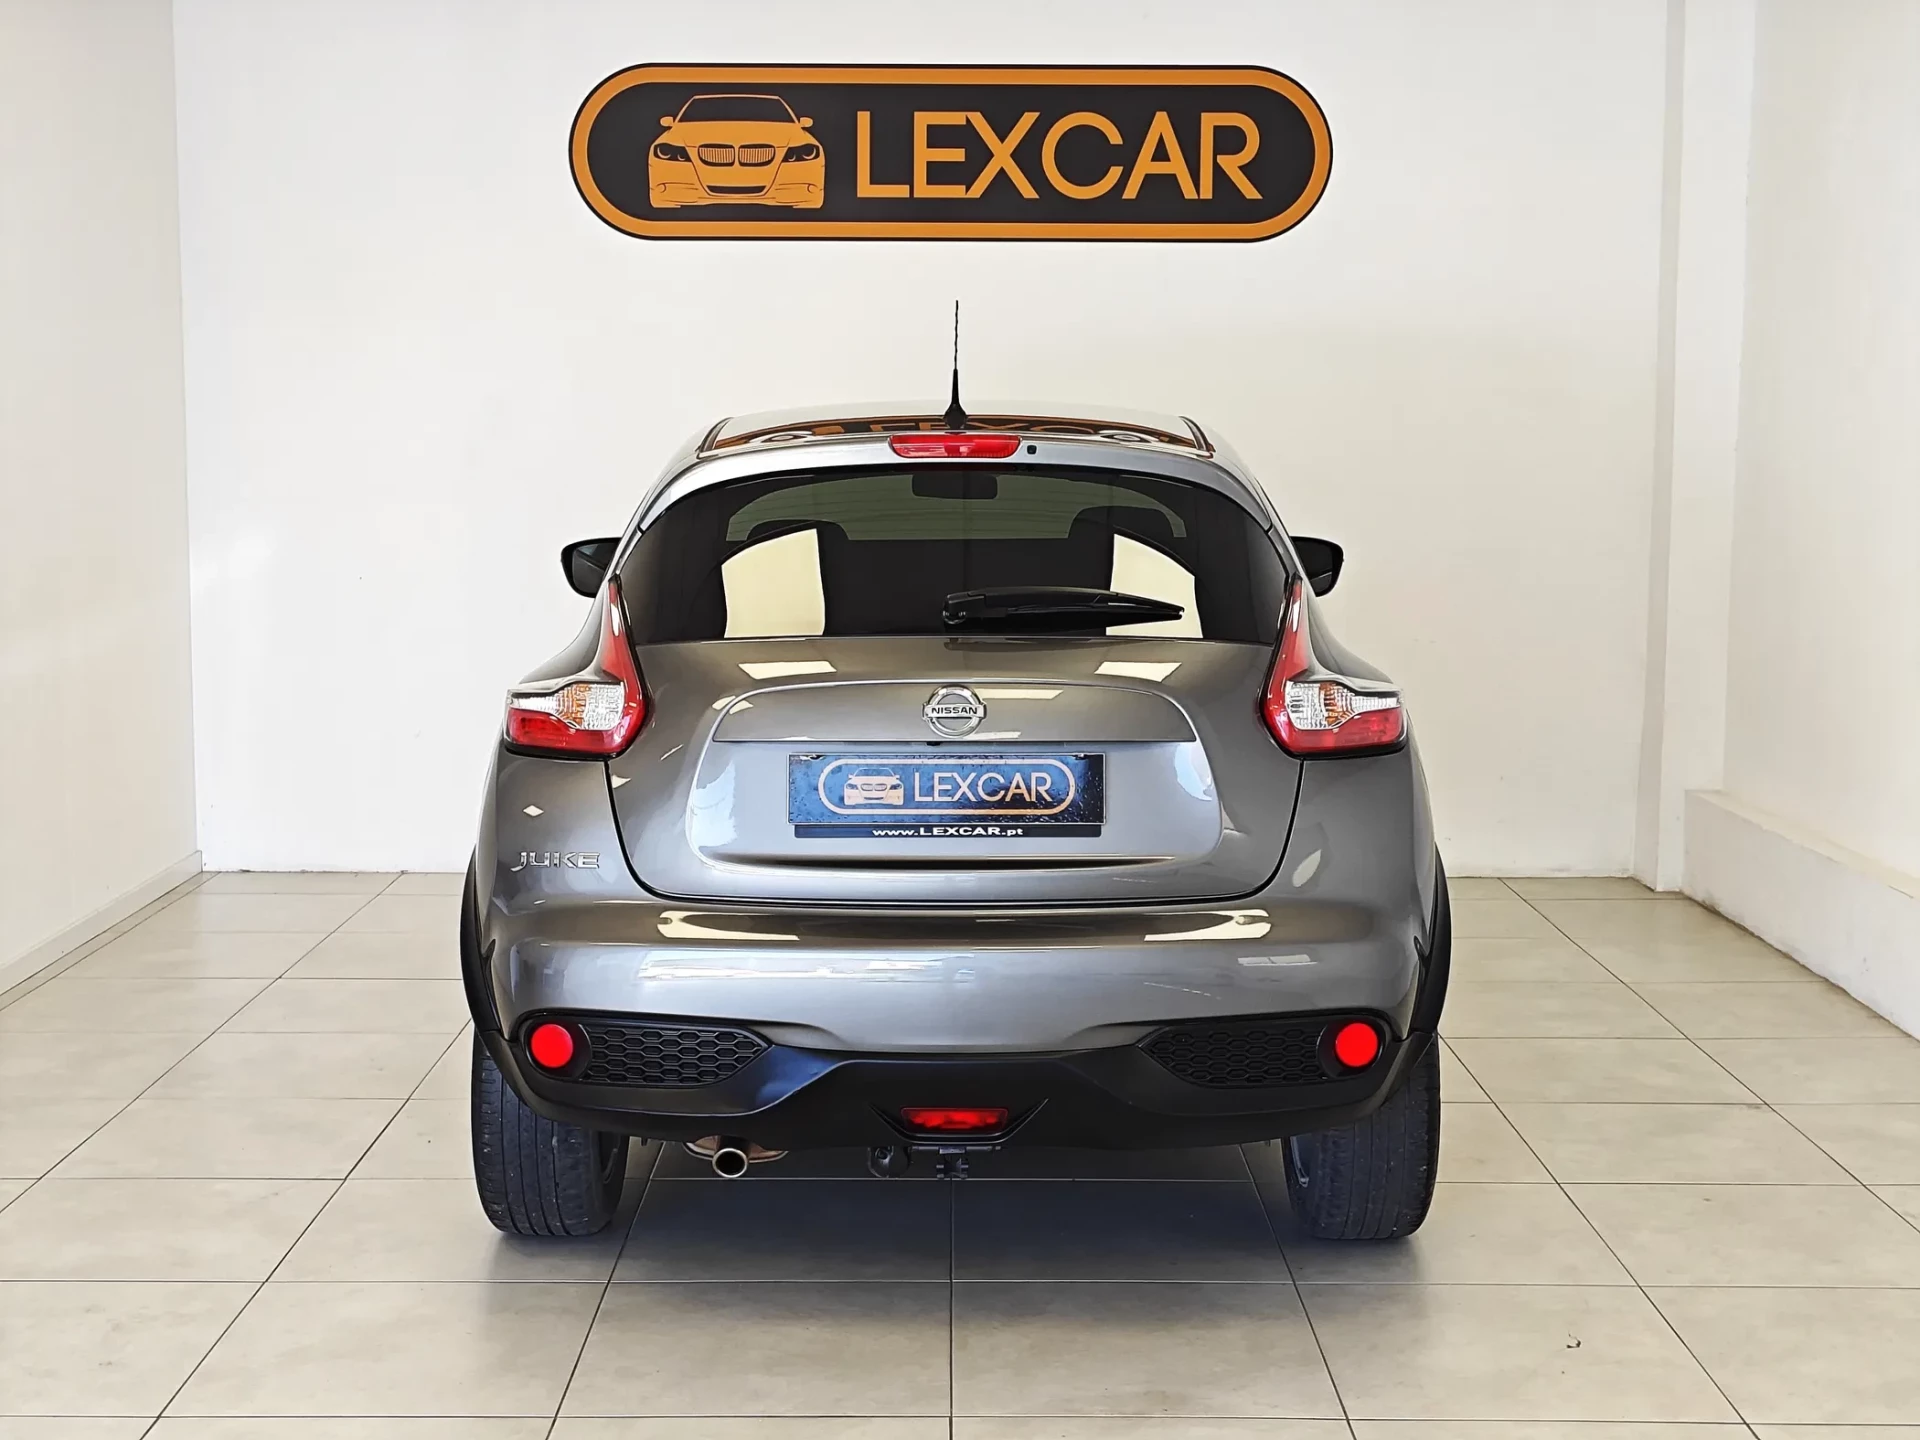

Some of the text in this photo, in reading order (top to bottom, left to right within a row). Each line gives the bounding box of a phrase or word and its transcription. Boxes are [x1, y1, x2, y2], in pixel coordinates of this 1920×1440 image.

[855, 110, 1263, 200] LEXCAR
[931, 706, 978, 715] NISSAN
[913, 772, 1053, 802] LEXCAR
[872, 826, 1024, 837] www.LEXCAR.pt
[510, 851, 600, 872] JUKE
